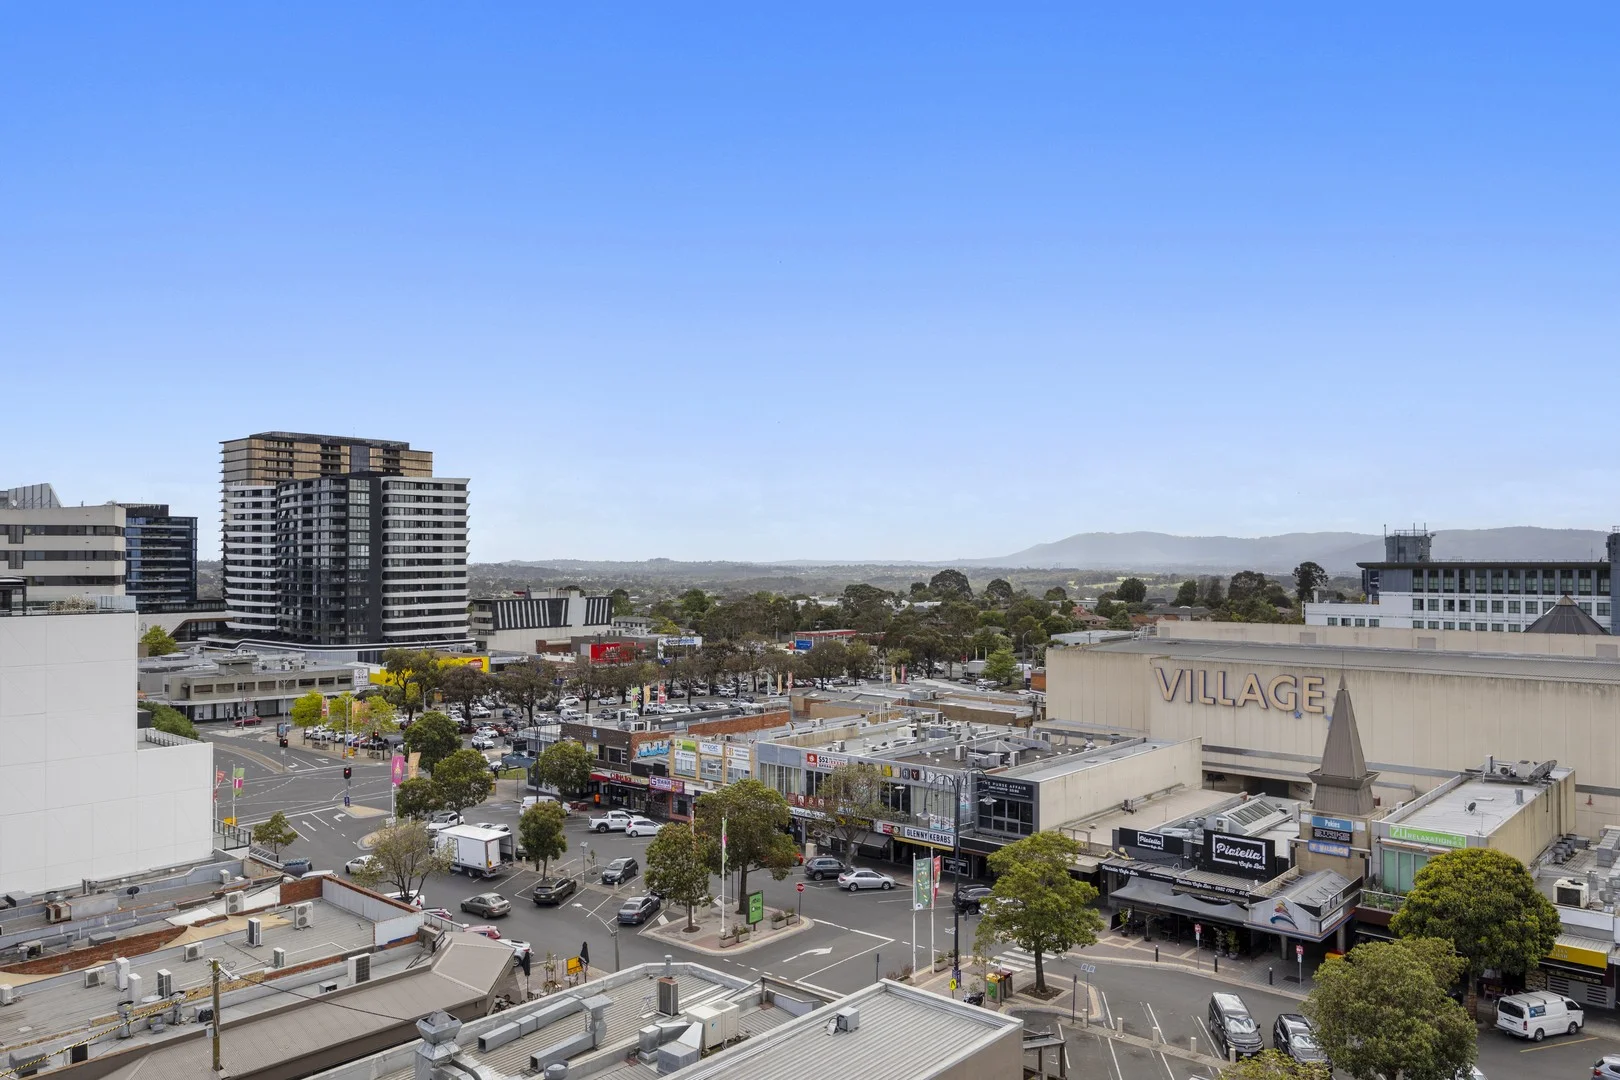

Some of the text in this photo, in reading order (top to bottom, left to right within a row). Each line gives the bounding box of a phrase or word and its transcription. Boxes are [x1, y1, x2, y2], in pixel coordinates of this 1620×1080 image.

[1154, 667, 1325, 713] VILLAGE
[906, 828, 928, 840] GLENNY
[929, 834, 951, 844] KEBABS
[1138, 835, 1162, 845] Piatella
[1407, 833, 1452, 845] RELAXATION
[1216, 842, 1262, 861] Piatella
[1238, 860, 1266, 870] Cafe Bar
